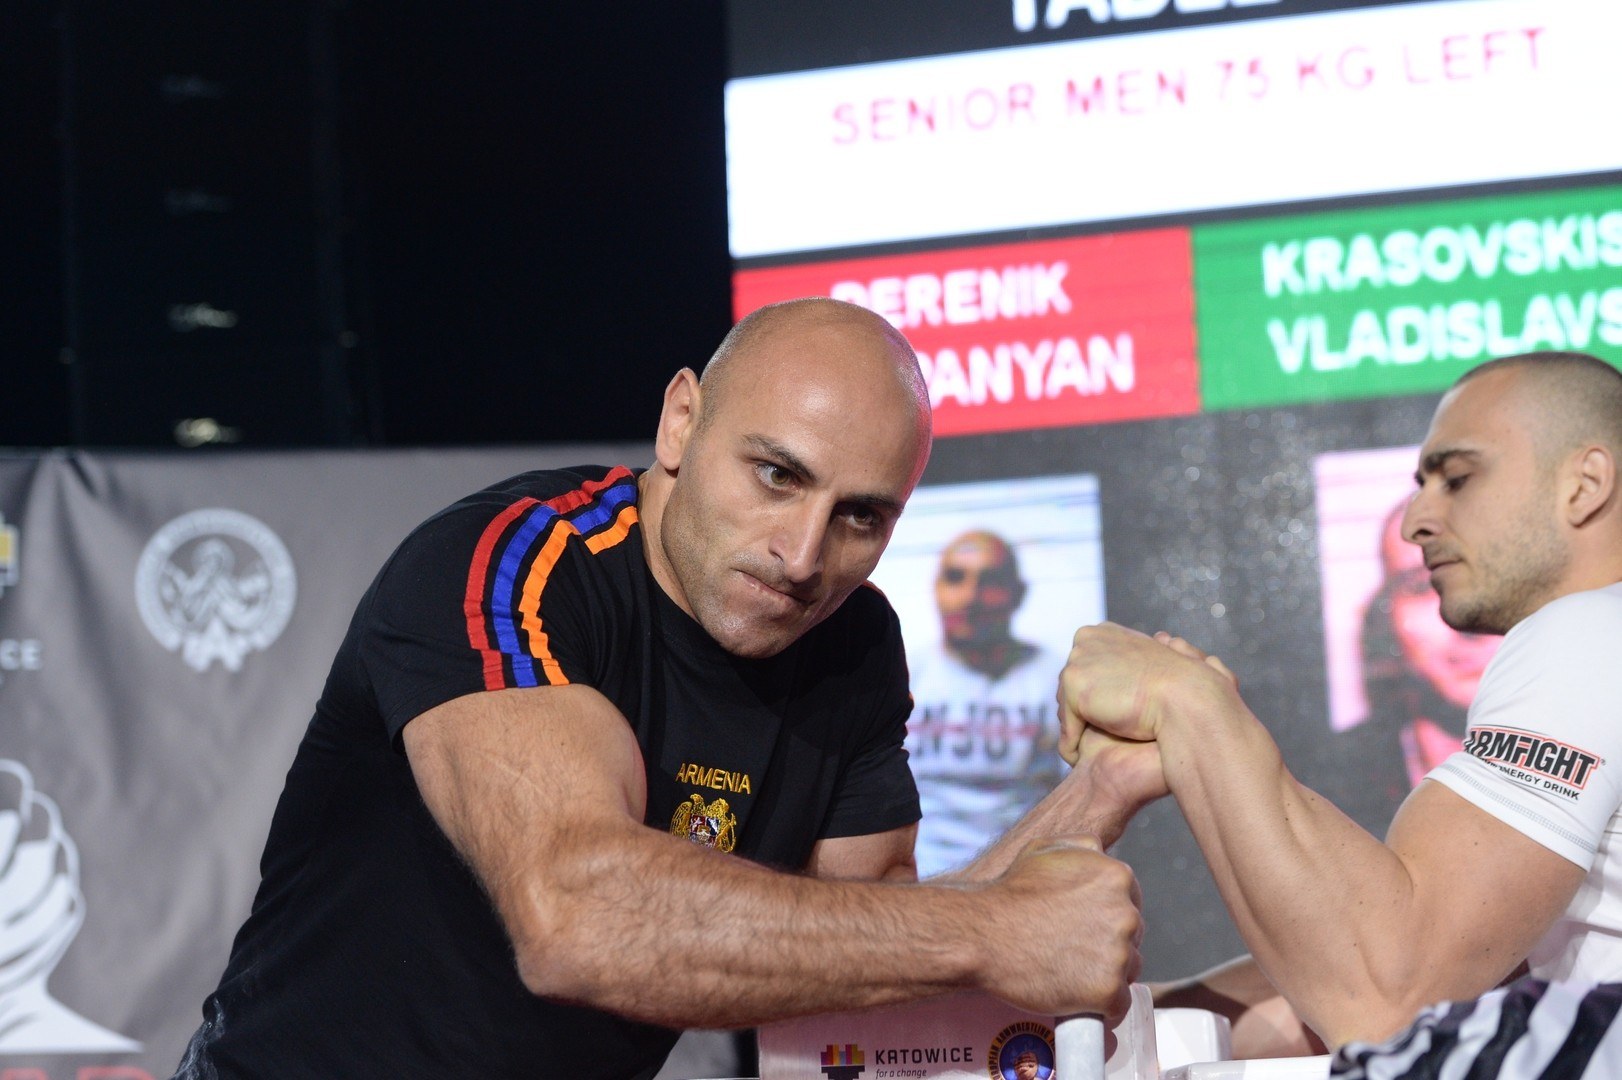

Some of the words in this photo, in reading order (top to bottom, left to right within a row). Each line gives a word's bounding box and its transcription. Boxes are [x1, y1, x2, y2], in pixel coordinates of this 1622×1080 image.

[832, 81, 1036, 145] SENIOR
[1064, 68, 1187, 117] MEN
[1215, 56, 1270, 100] 75
[1296, 45, 1375, 91] KG
[1402, 26, 1546, 84] LEFT
[1261, 209, 1622, 297] KRASOVSKIS
[1266, 286, 1622, 374] VLADISLAVS
[675, 763, 751, 795] ARMENIA
[1543, 780, 1581, 801] DRINK
[875, 1047, 974, 1065] KATOWICE
[876, 1068, 888, 1079] for
[889, 1070, 895, 1078] a
[896, 1068, 928, 1079] change
